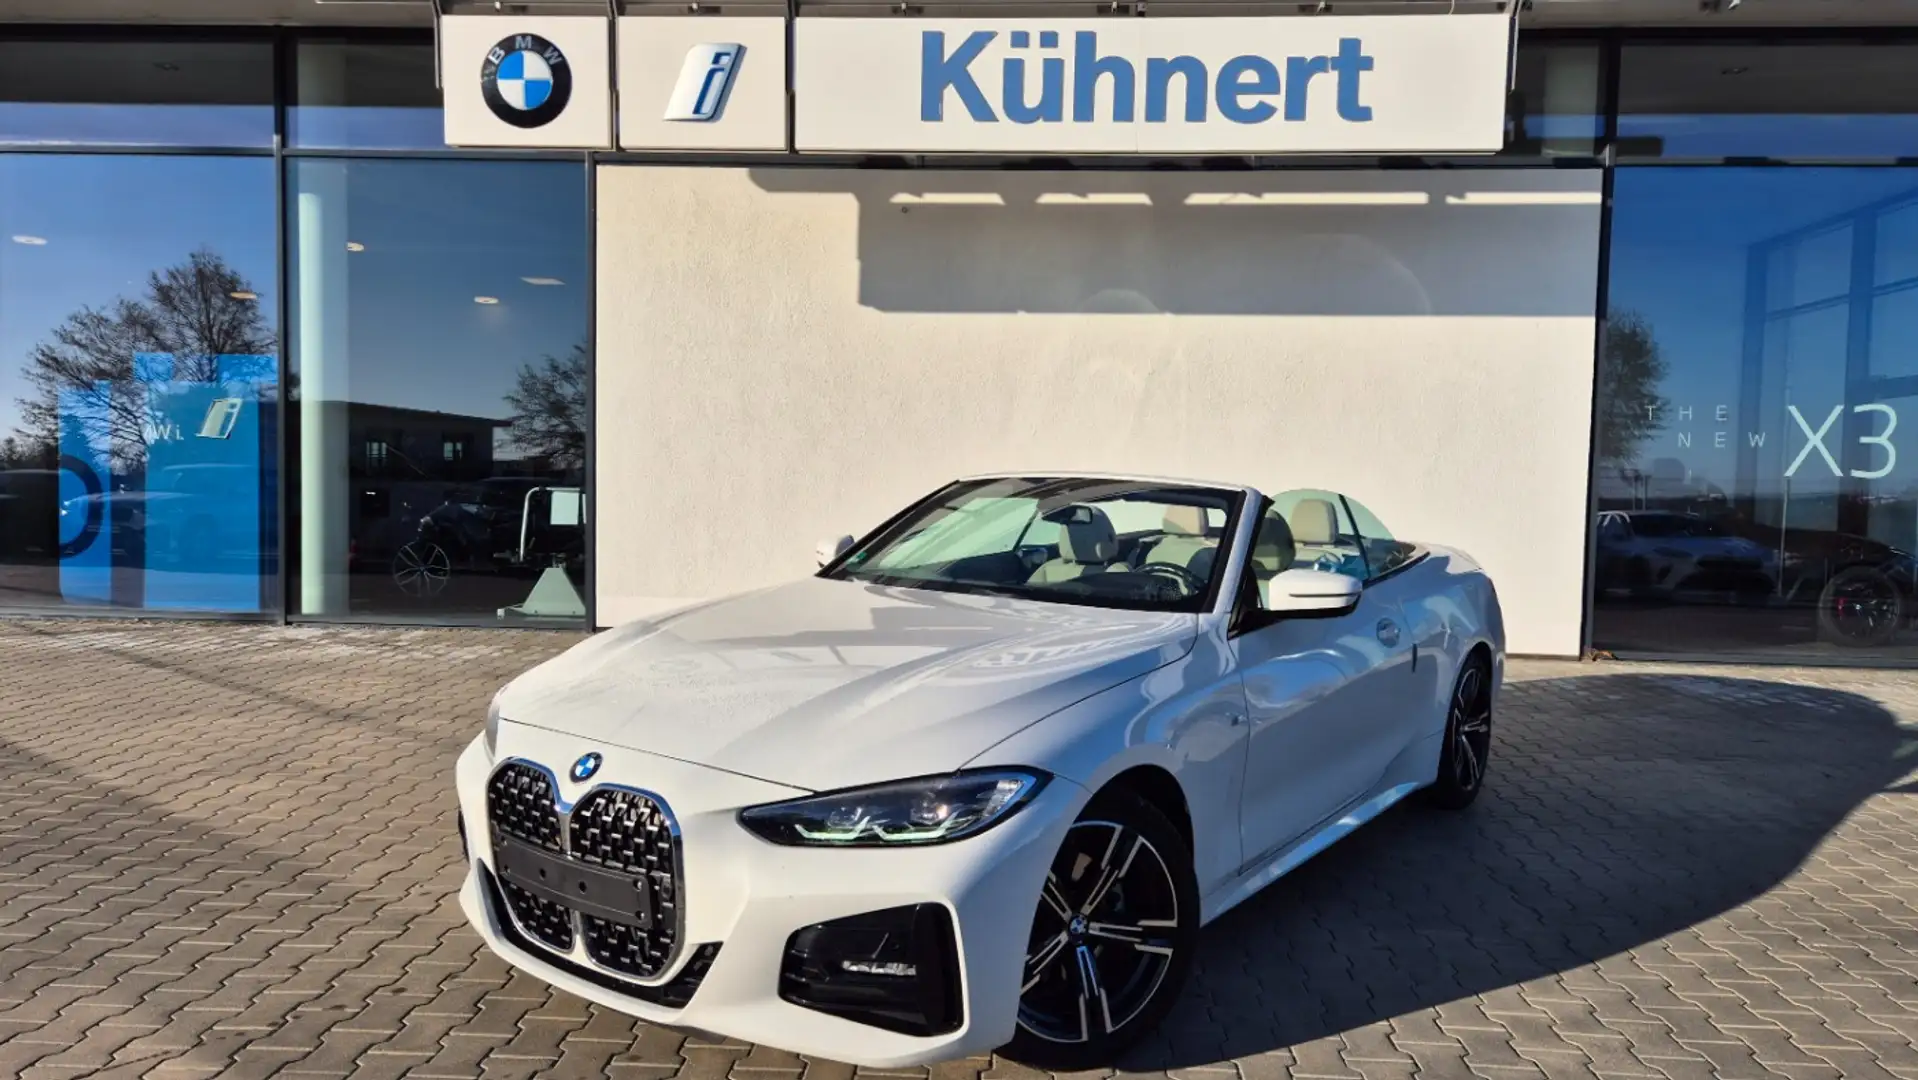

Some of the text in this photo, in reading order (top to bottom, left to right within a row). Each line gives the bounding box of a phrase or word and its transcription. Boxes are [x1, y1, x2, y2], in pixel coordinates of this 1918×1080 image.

[488, 35, 563, 66] BMW
[921, 31, 1373, 124] Kühnert
[1644, 404, 1728, 421] THE
[1677, 431, 1766, 449] NEW
[1783, 403, 1898, 479] X3
